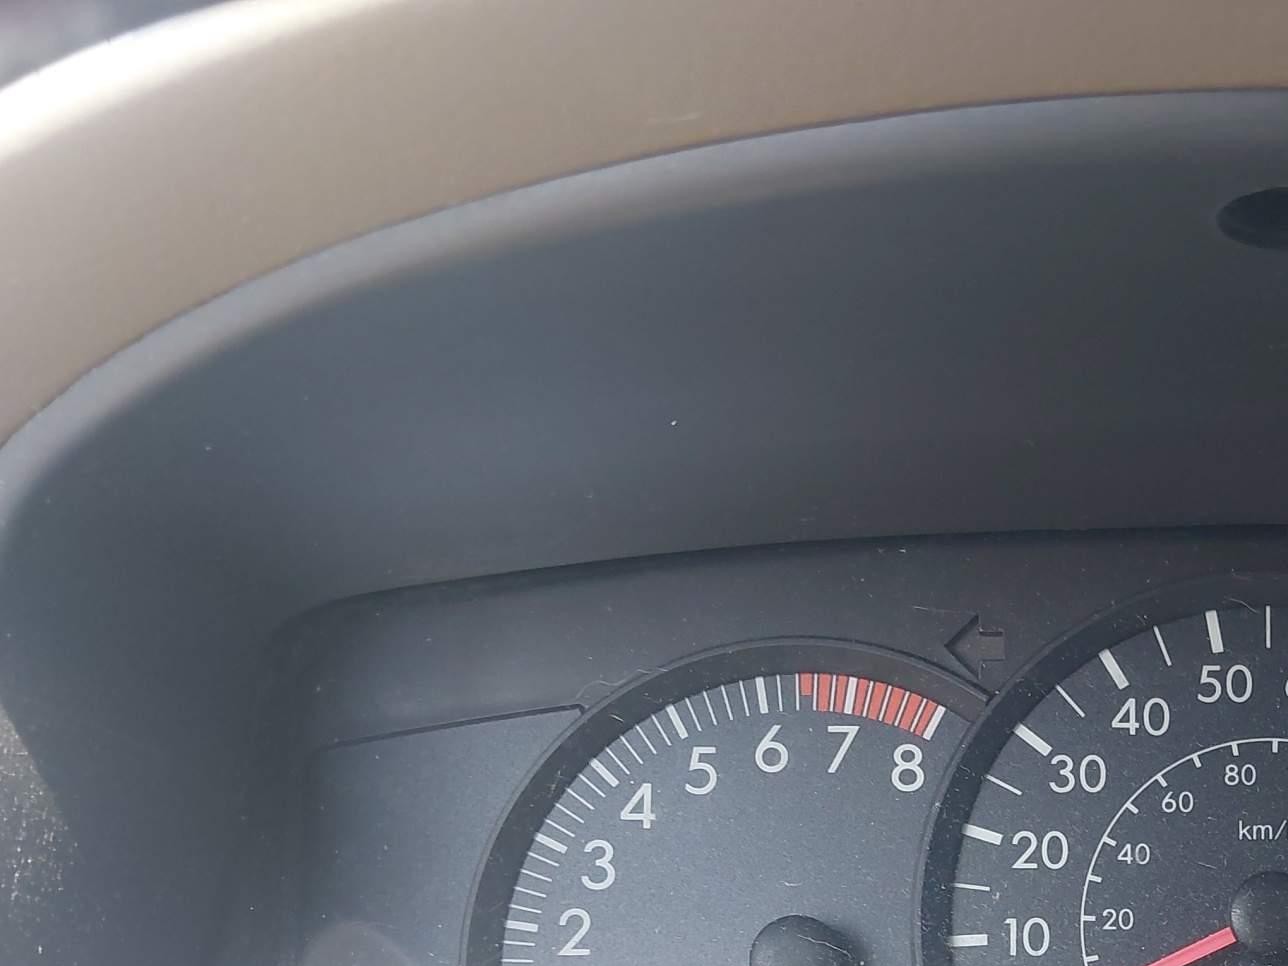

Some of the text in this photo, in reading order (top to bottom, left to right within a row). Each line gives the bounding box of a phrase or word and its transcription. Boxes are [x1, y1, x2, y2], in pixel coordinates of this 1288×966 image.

[1196, 664, 1253, 702] 50
[1111, 697, 1170, 736] 40
[754, 724, 789, 773] 6
[826, 725, 860, 773] 7
[891, 743, 925, 792] 8
[685, 746, 718, 795] 5
[1048, 754, 1107, 793] 30
[1224, 764, 1257, 787] 80
[620, 783, 657, 829] 4
[1161, 791, 1194, 814] 60
[581, 839, 617, 890] 3
[1011, 830, 1069, 870] 20
[1116, 843, 1151, 865] 40
[557, 908, 592, 956] 2
[1003, 916, 1051, 956] 10
[1102, 908, 1135, 931] 20
